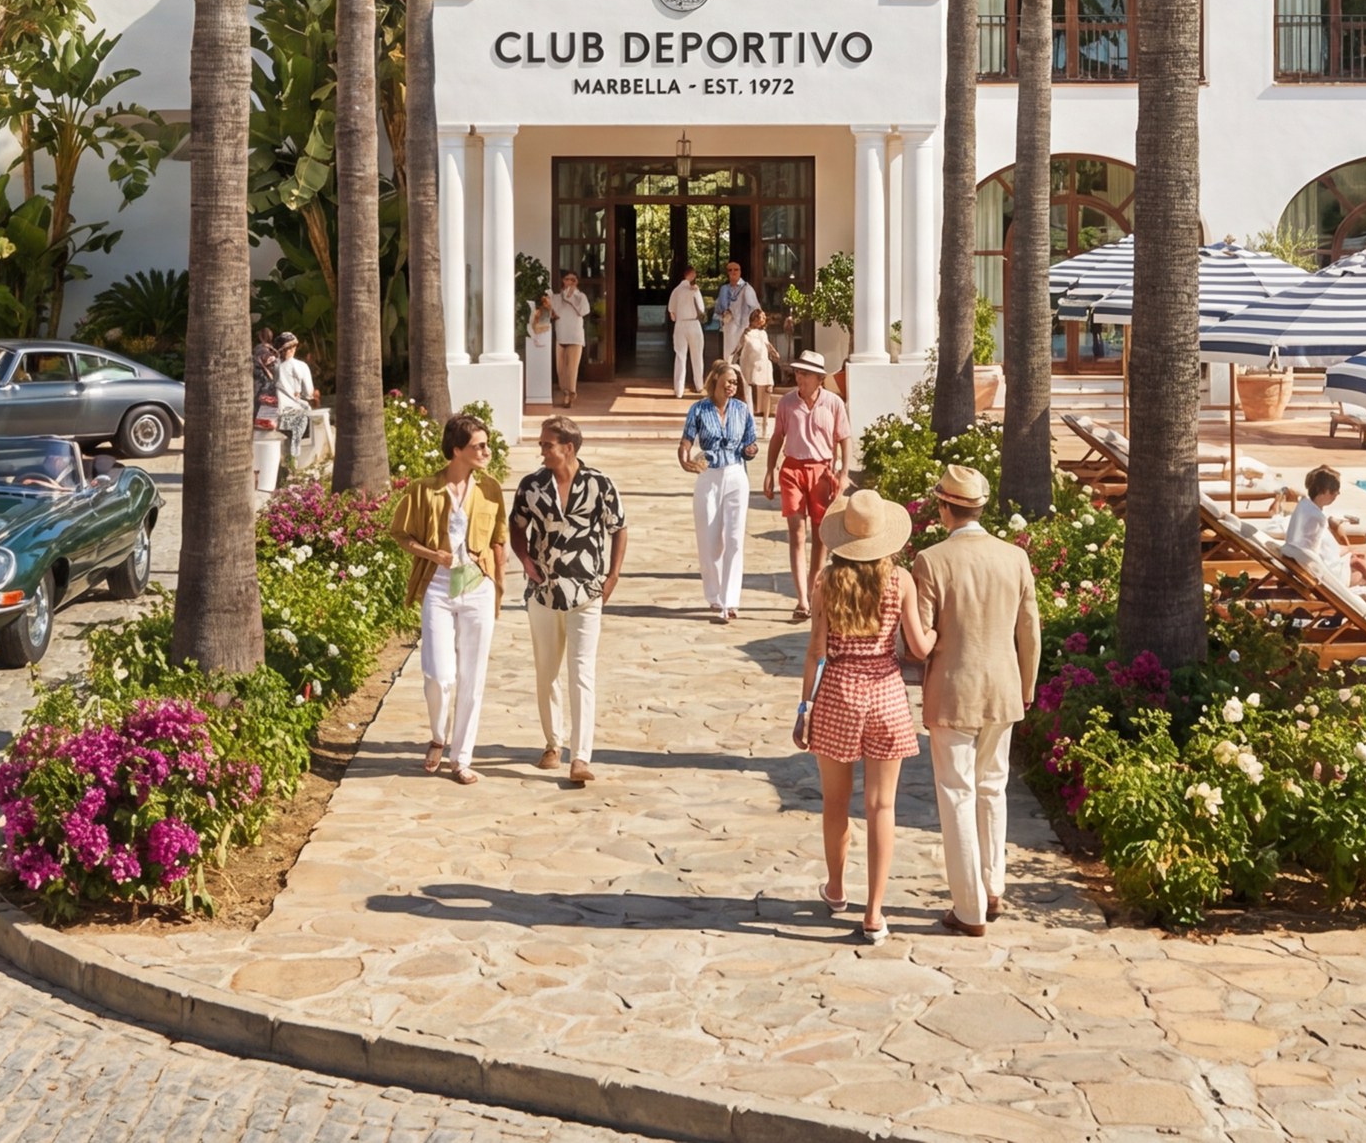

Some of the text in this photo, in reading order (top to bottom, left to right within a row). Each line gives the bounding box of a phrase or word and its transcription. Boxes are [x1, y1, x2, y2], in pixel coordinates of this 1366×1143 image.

[494, 31, 874, 64] CLUB DEPORTIVO
[573, 78, 681, 96] MARBELLA
[749, 78, 795, 96] 1972
